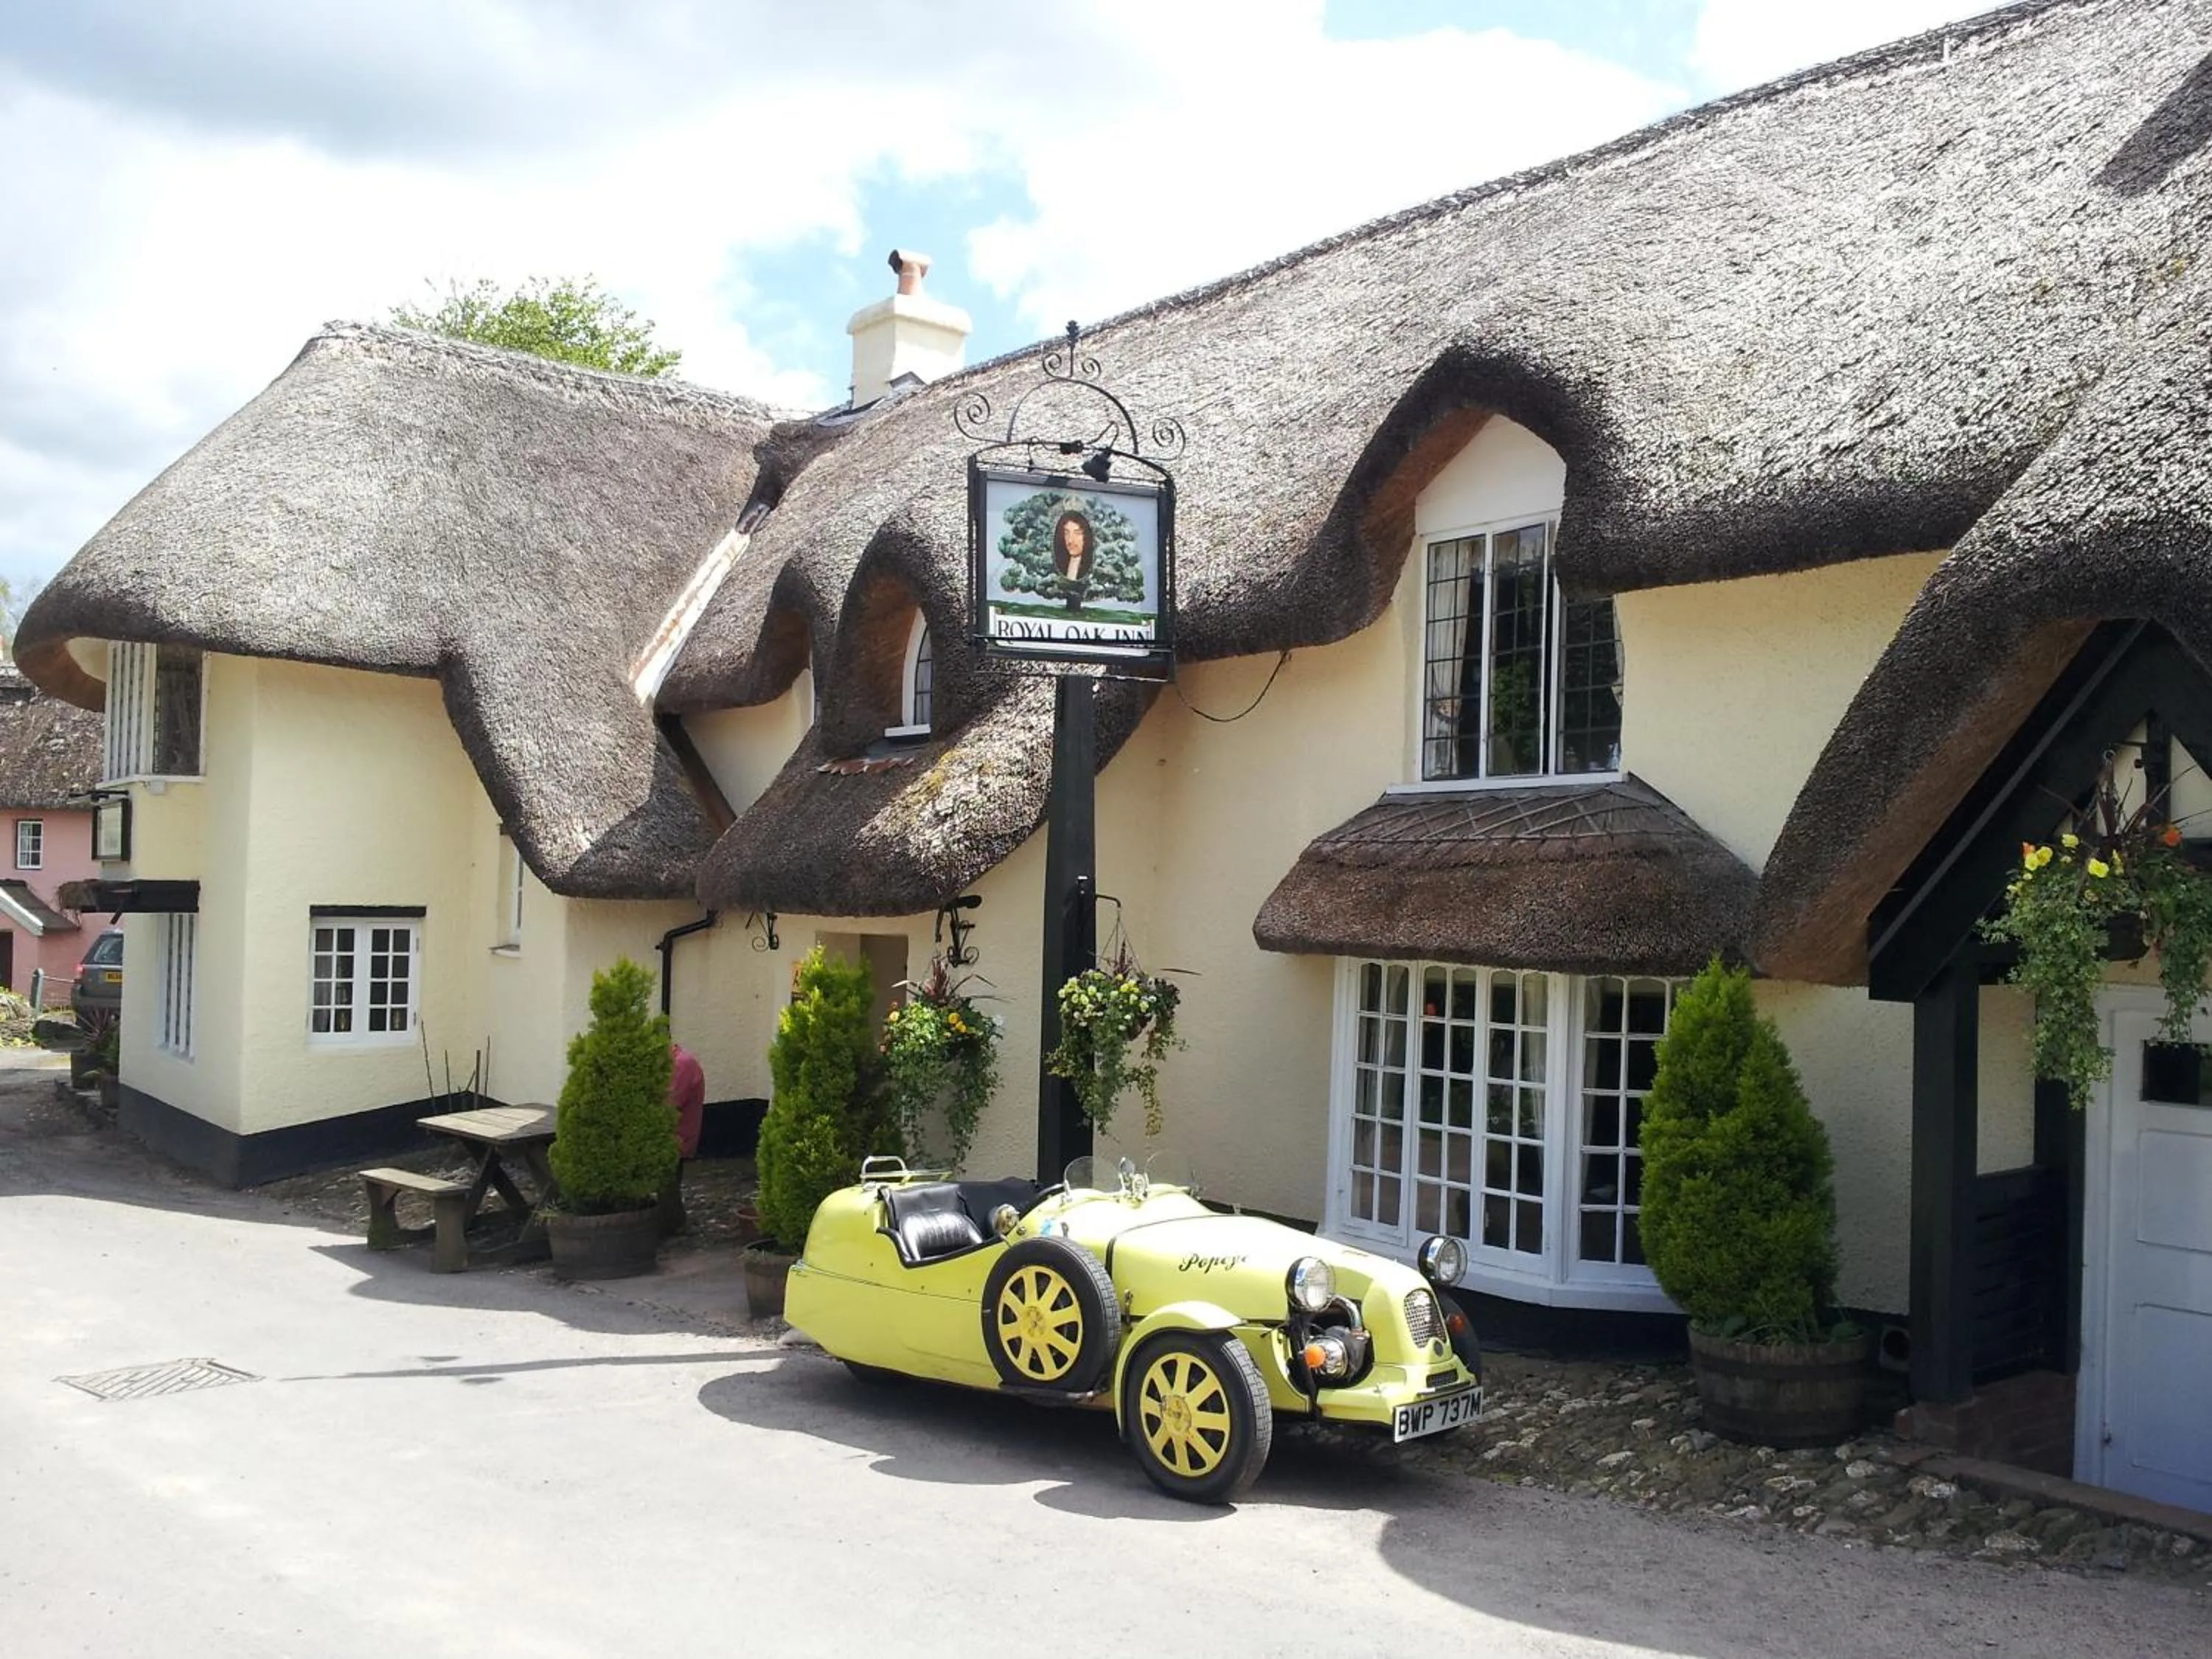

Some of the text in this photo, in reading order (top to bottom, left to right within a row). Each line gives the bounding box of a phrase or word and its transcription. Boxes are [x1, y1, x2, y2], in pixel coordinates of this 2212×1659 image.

[997, 619, 1151, 644] ROYAL OAK INN
[1398, 1391, 1481, 1436] BWP 737M
